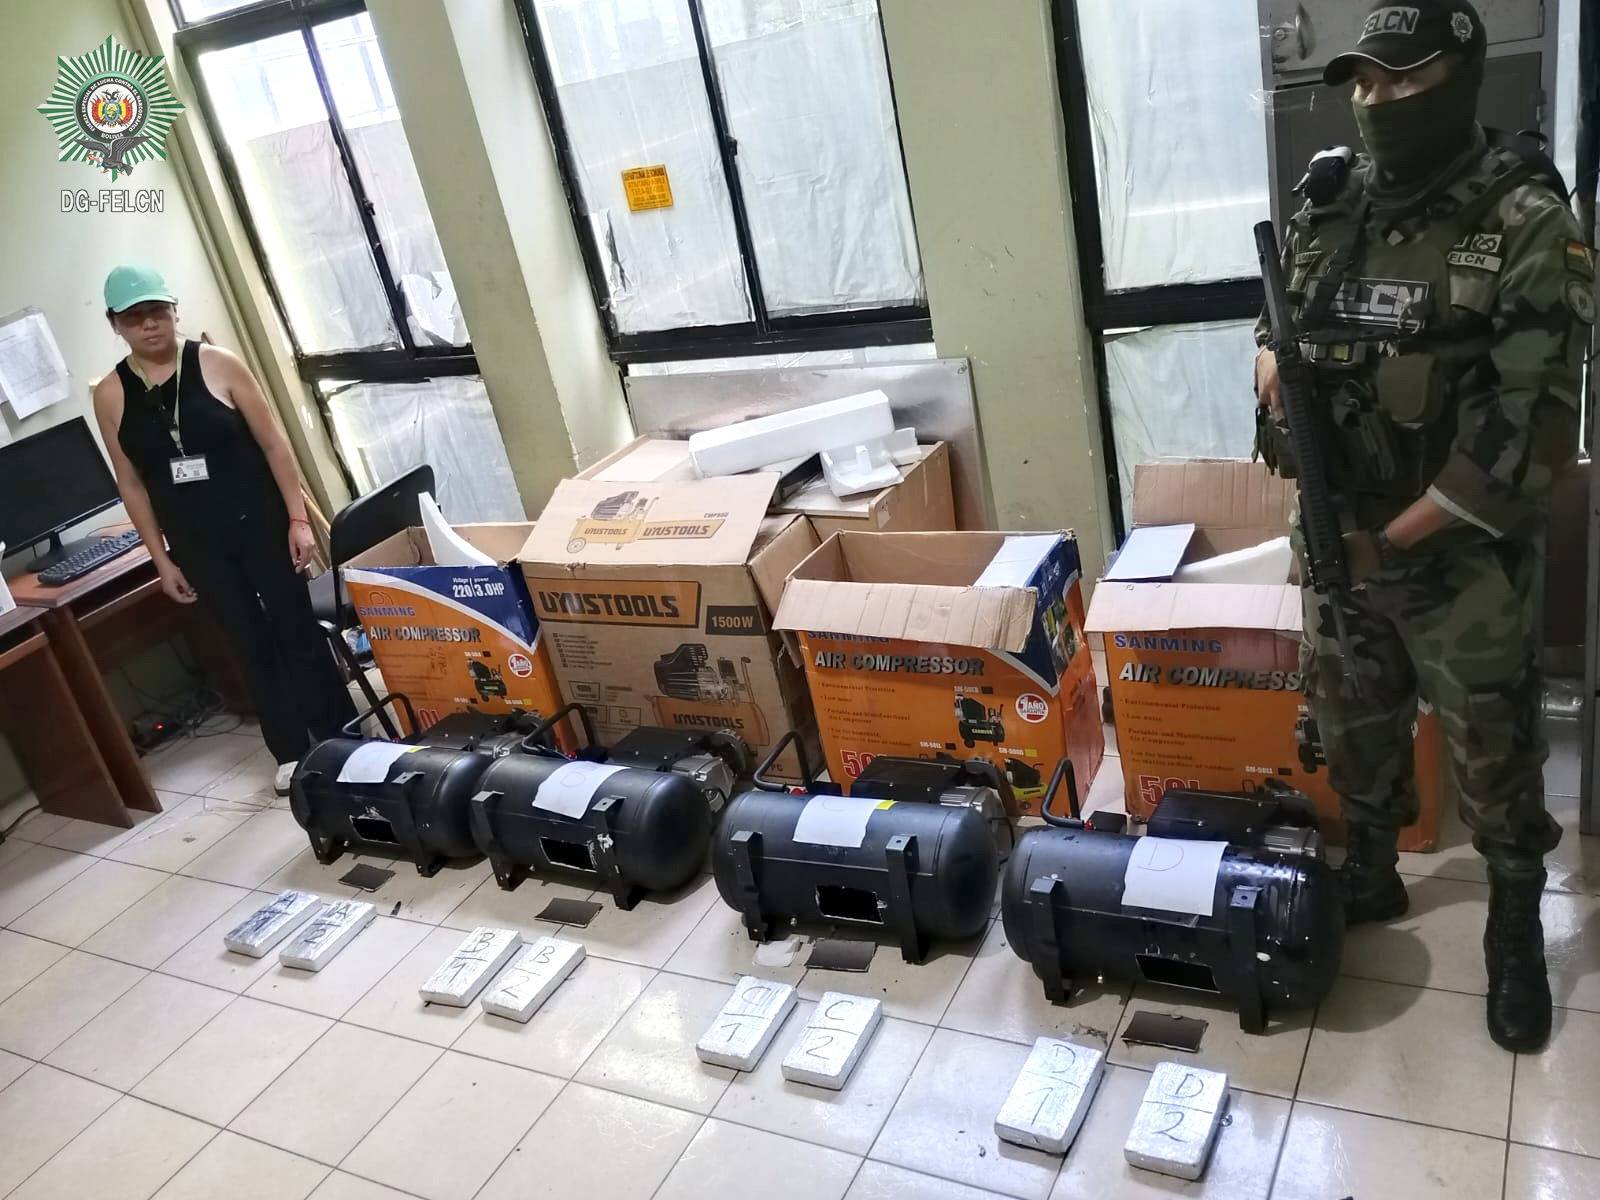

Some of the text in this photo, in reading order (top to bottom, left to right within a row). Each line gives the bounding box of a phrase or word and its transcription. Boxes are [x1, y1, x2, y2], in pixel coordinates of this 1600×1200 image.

[643, 525, 710, 536] UYUSTOOLS
[452, 582, 504, 598] 220 3.0HP
[360, 606, 415, 617] SANMING
[538, 591, 680, 618] UYUSTOOLS
[712, 616, 753, 628] 1500W
[370, 625, 481, 643] AIR COMPRESSOR
[1114, 634, 1222, 653] SANMING
[815, 651, 985, 676] AIR COMPRESSOR
[1120, 662, 1162, 683] AIR
[304, 928, 327, 944] 2
[461, 932, 496, 953] B
[530, 945, 555, 964] B
[501, 976, 530, 998] 2
[742, 986, 771, 1006] C
[825, 1000, 854, 1020] C
[720, 1022, 742, 1042] 1
[806, 1035, 834, 1060] 2
[1052, 1043, 1076, 1074] D
[1166, 1073, 1204, 1098] D
[1025, 1087, 1054, 1126] 1
[1153, 1111, 1190, 1142] 2
